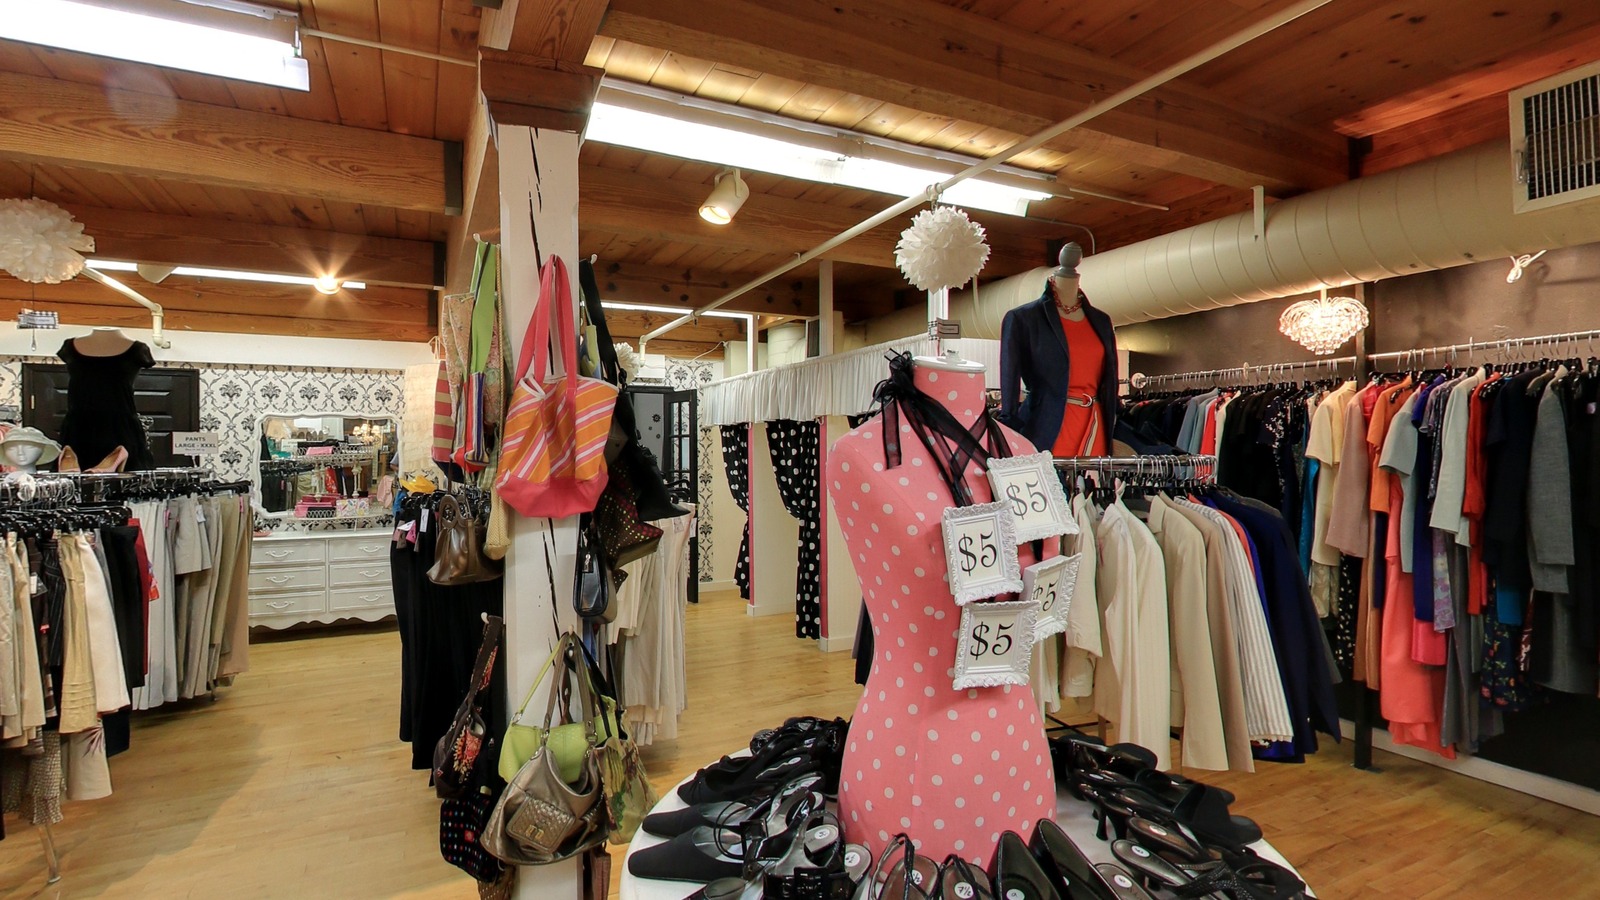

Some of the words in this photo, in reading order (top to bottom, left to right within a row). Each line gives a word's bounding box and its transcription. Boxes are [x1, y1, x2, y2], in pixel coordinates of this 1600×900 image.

[1006, 480, 1047, 520] $5
[958, 531, 997, 576] $5
[970, 621, 1015, 660] $5
